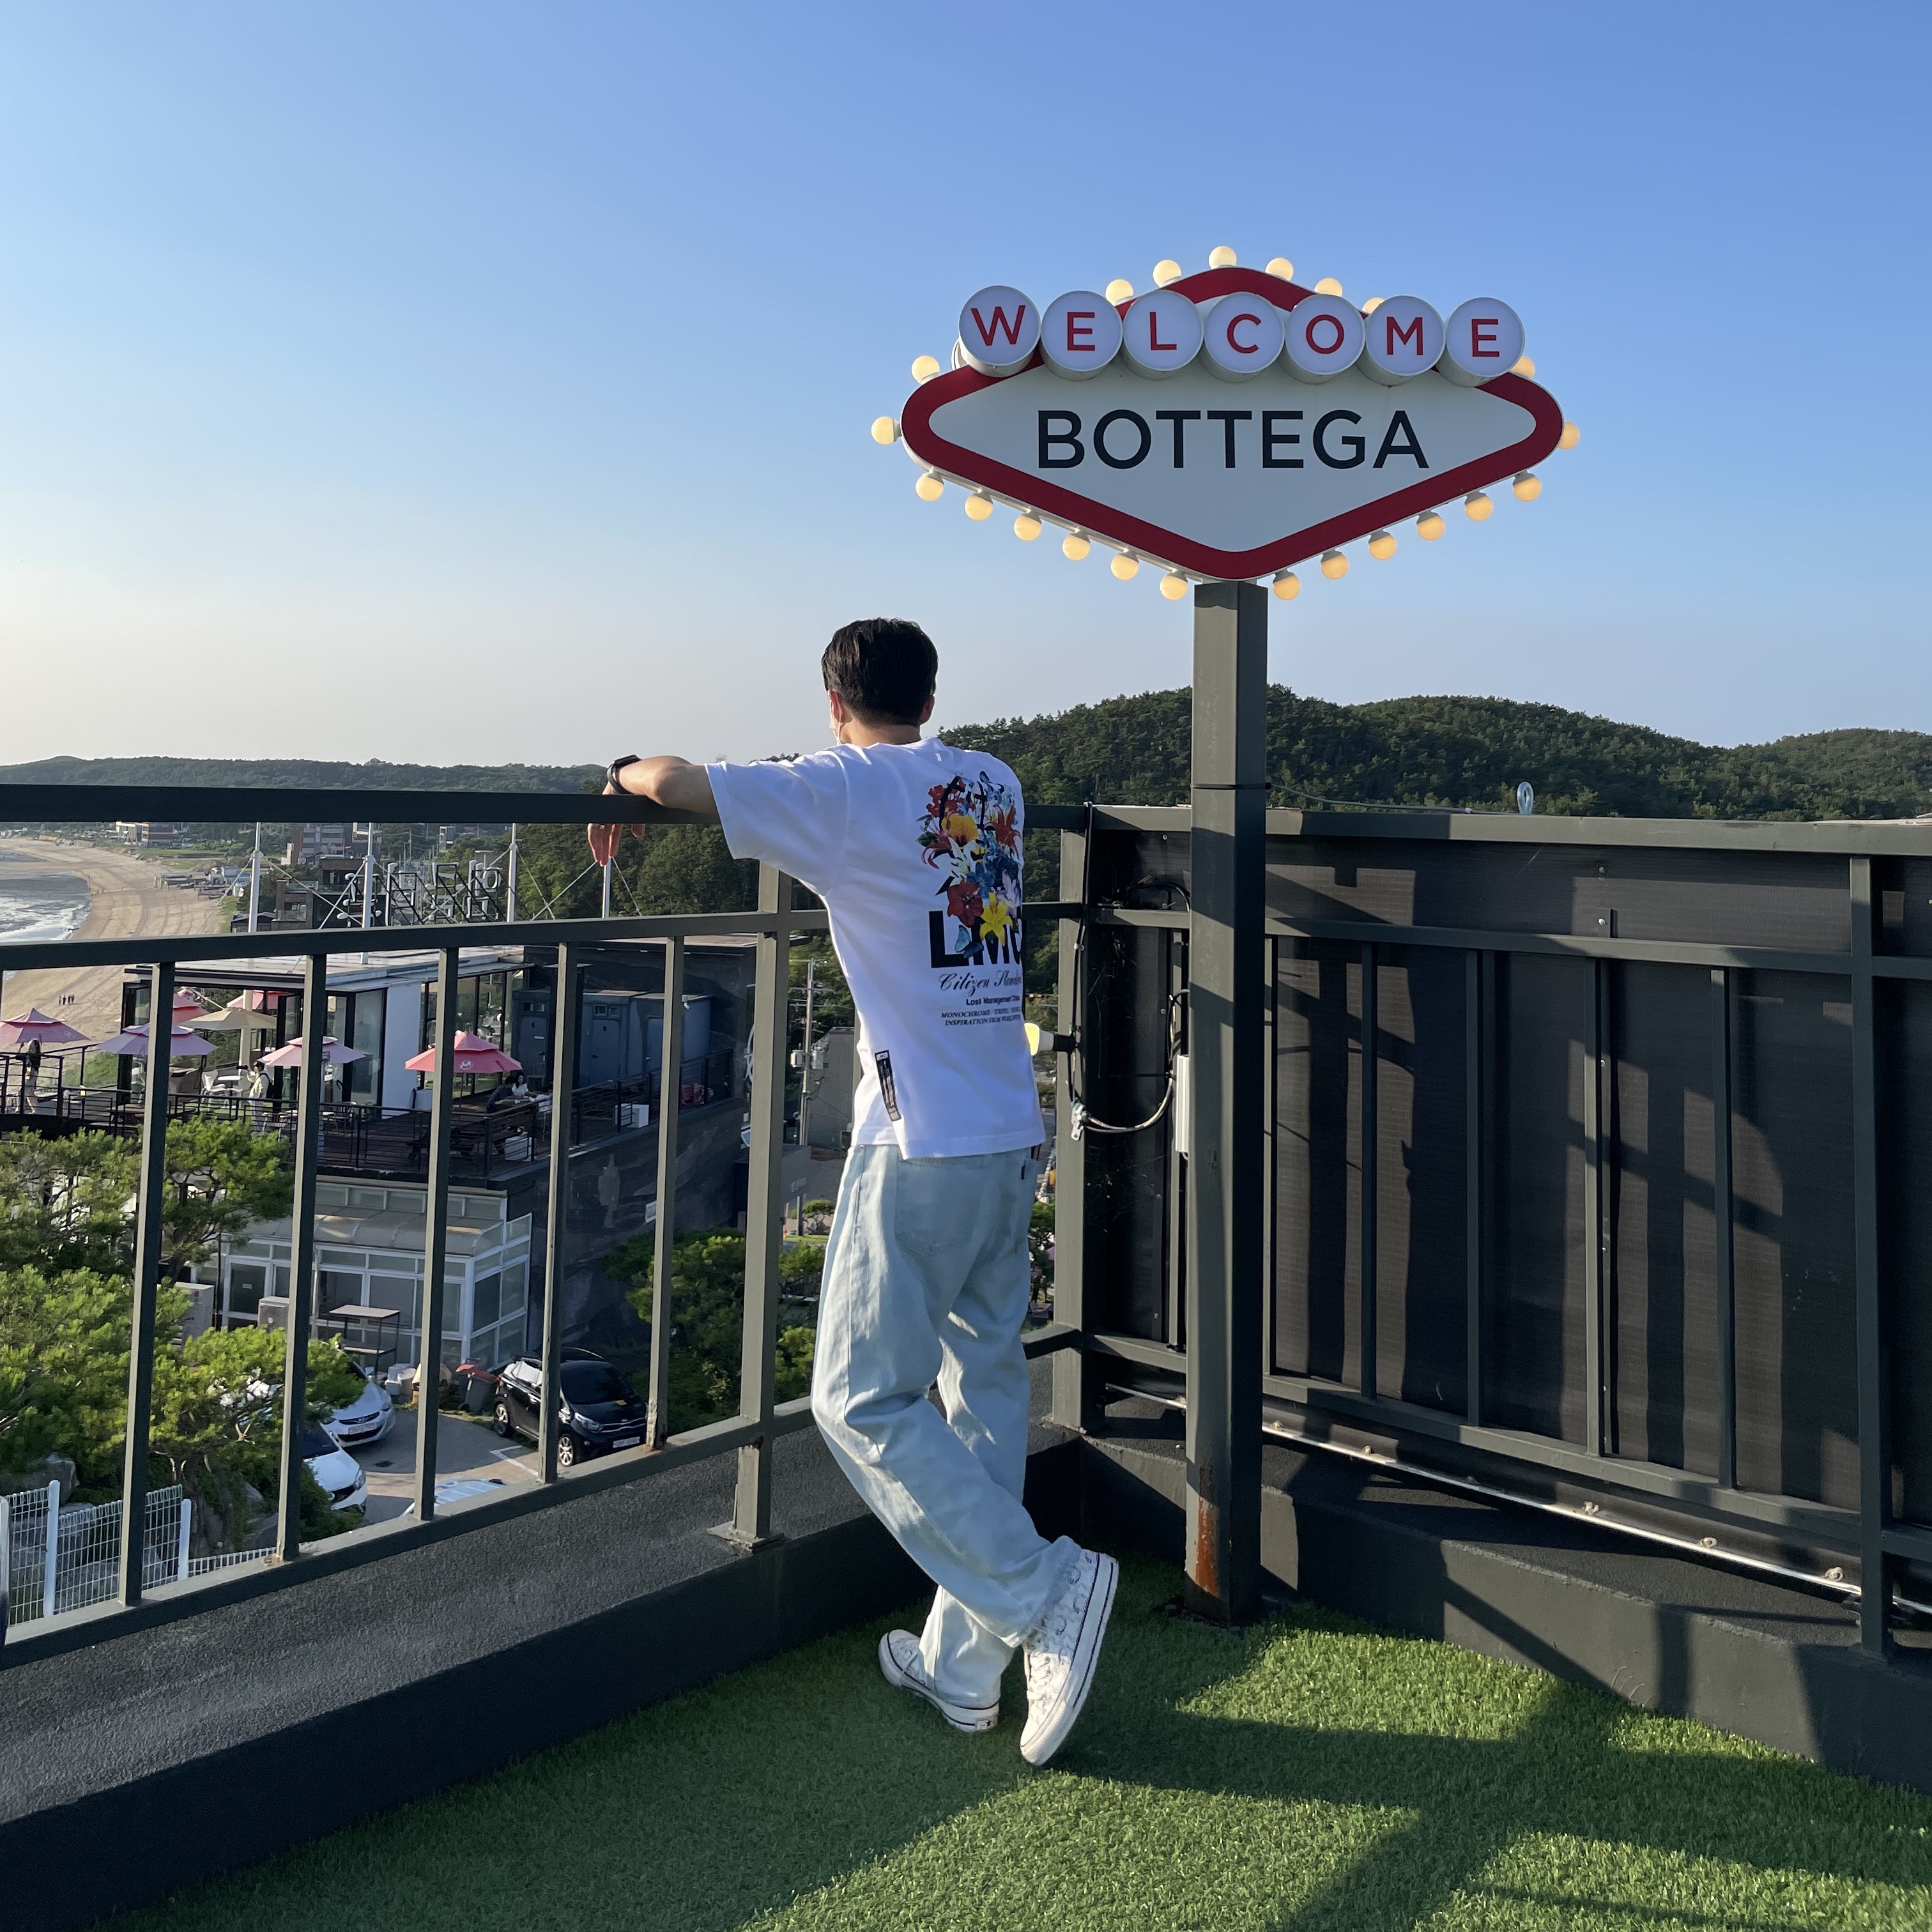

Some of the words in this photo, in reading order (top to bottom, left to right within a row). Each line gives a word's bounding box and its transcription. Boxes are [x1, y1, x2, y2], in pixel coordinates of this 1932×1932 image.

[970, 304, 1500, 358] WELCOME
[1037, 409, 1430, 470] BOTTEGA
[939, 972, 990, 997] Citizen
[945, 1018, 988, 1026] INSPIRATION
